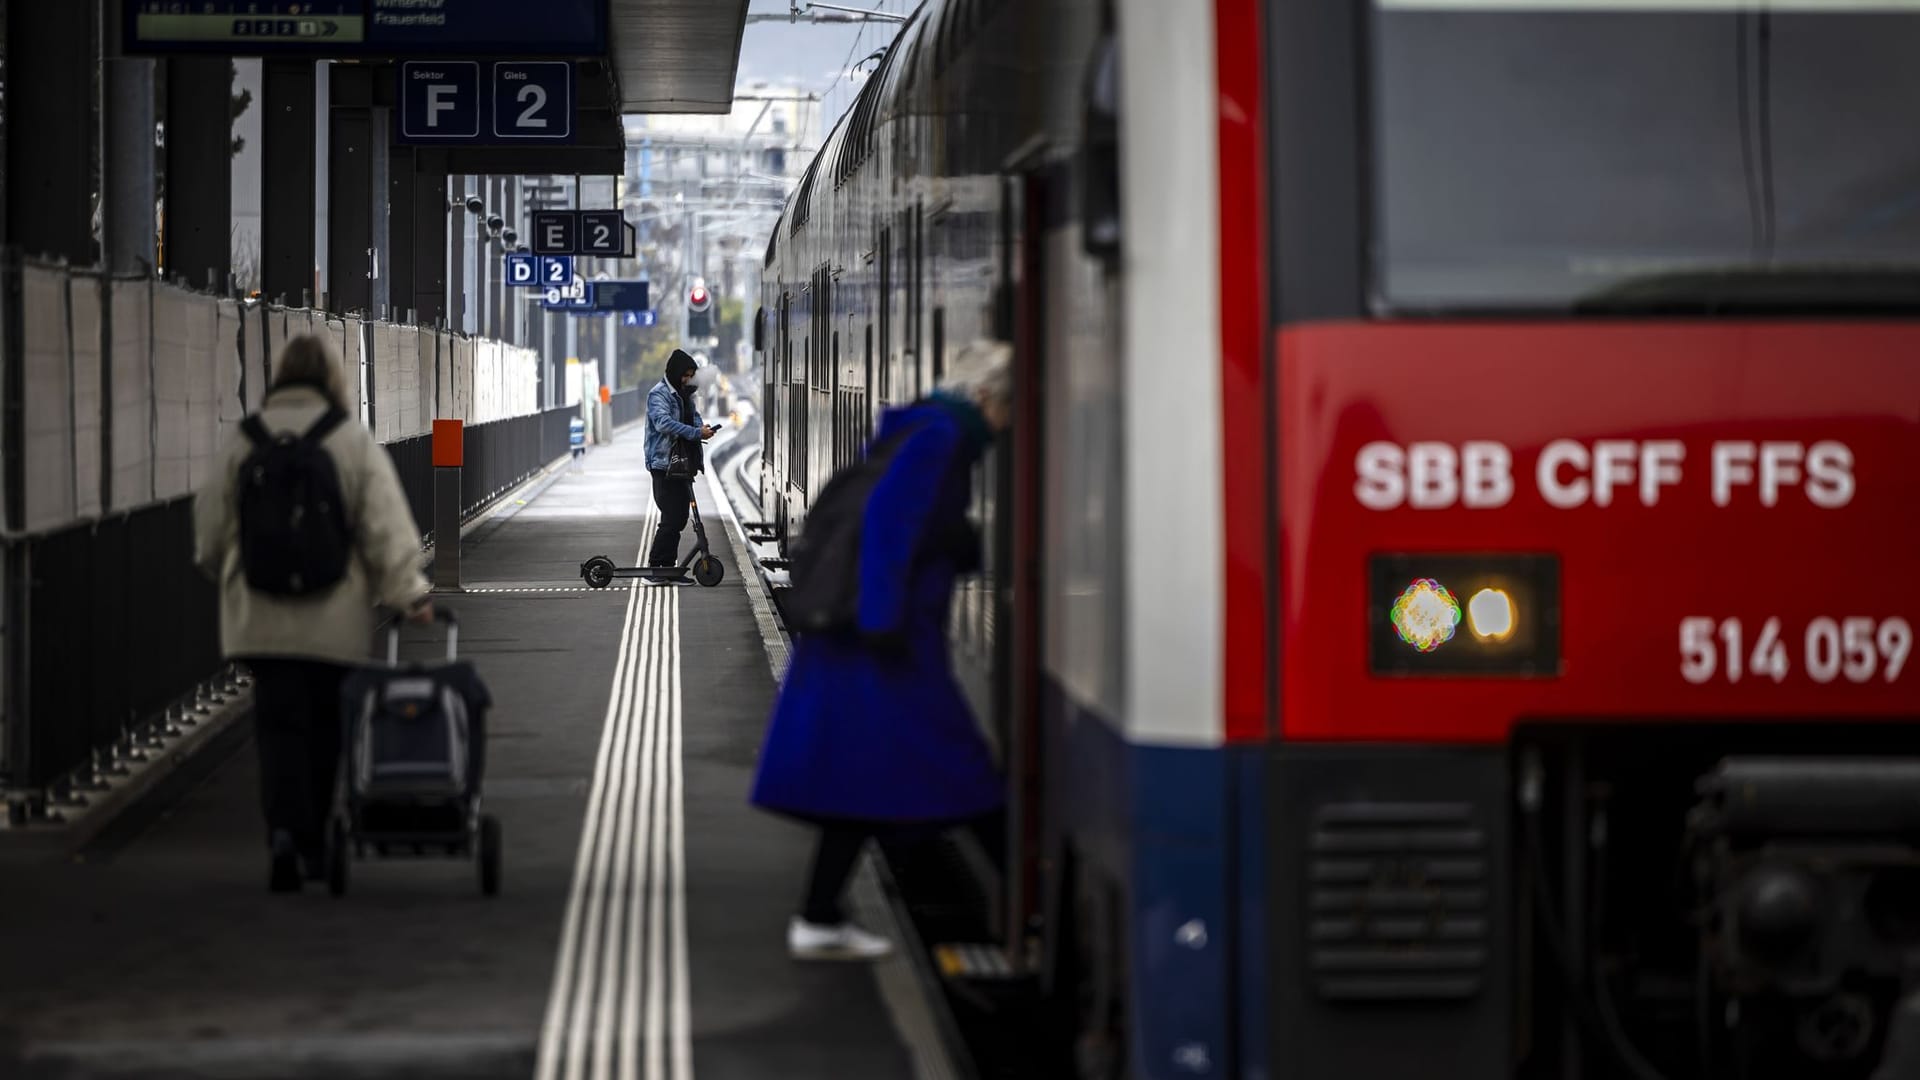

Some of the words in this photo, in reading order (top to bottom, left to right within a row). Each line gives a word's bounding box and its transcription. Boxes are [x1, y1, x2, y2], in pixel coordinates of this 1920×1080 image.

[374, 12, 445, 25] Frauenfeld
[413, 71, 445, 80] Sektor
[504, 71, 528, 80] Gleis
[427, 85, 458, 127] F
[516, 84, 548, 127] 2
[546, 225, 565, 248] E
[593, 225, 610, 248] 2
[514, 262, 531, 281] D
[550, 262, 564, 281] 2
[627, 311, 637, 324] A
[1354, 441, 1515, 510] SBB
[1536, 439, 1687, 508] CFF
[1711, 440, 1857, 508] FFS
[1679, 616, 1790, 684] 514
[1804, 616, 1914, 684] 059
